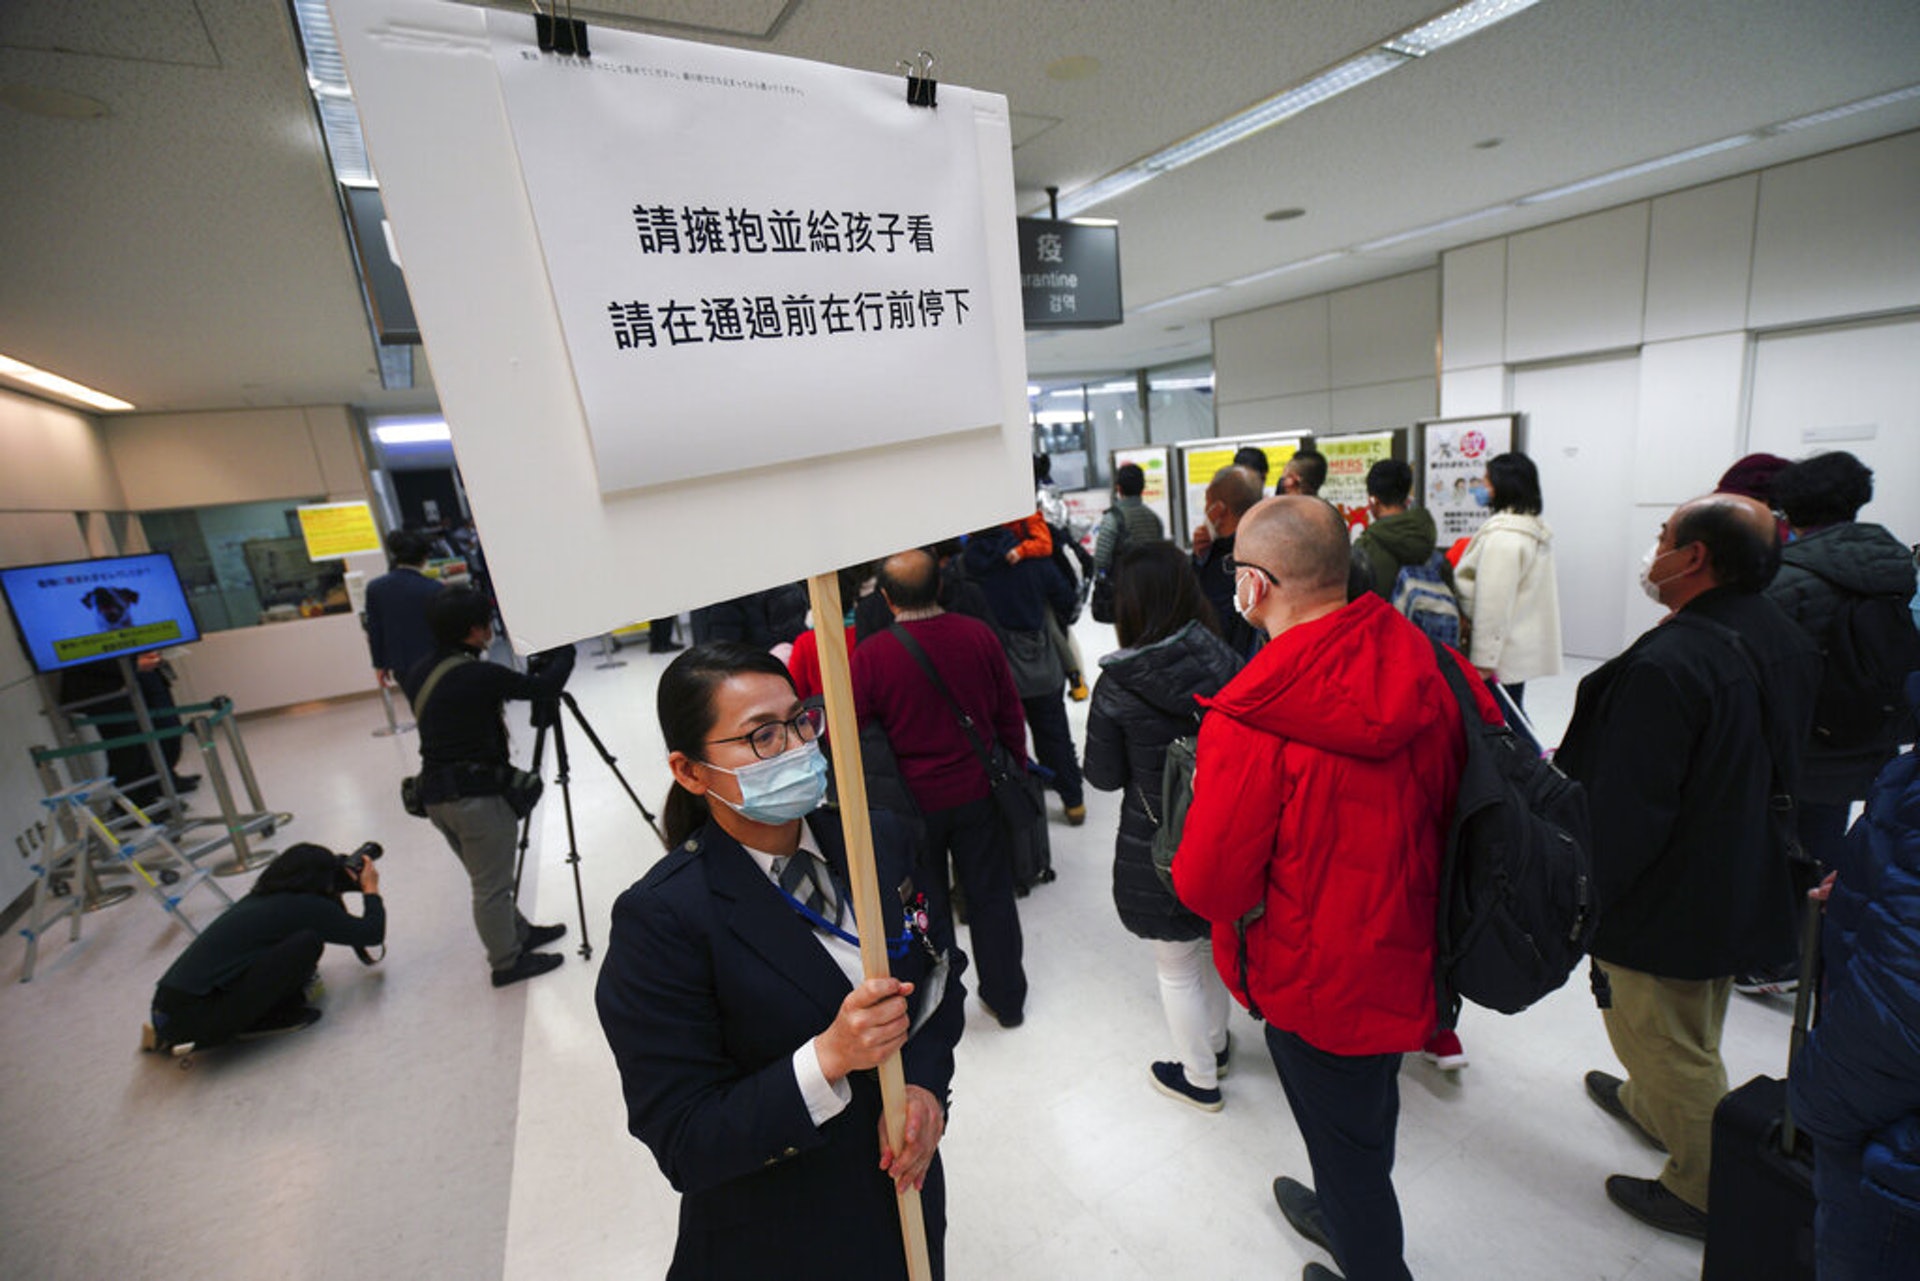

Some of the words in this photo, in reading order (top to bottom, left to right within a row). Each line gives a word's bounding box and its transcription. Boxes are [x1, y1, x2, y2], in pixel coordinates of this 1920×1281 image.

[633, 205, 934, 255] 請擁抱並給孩子看
[1037, 232, 1064, 263] 疫
[608, 288, 970, 349] 請在通過前在行前停下
